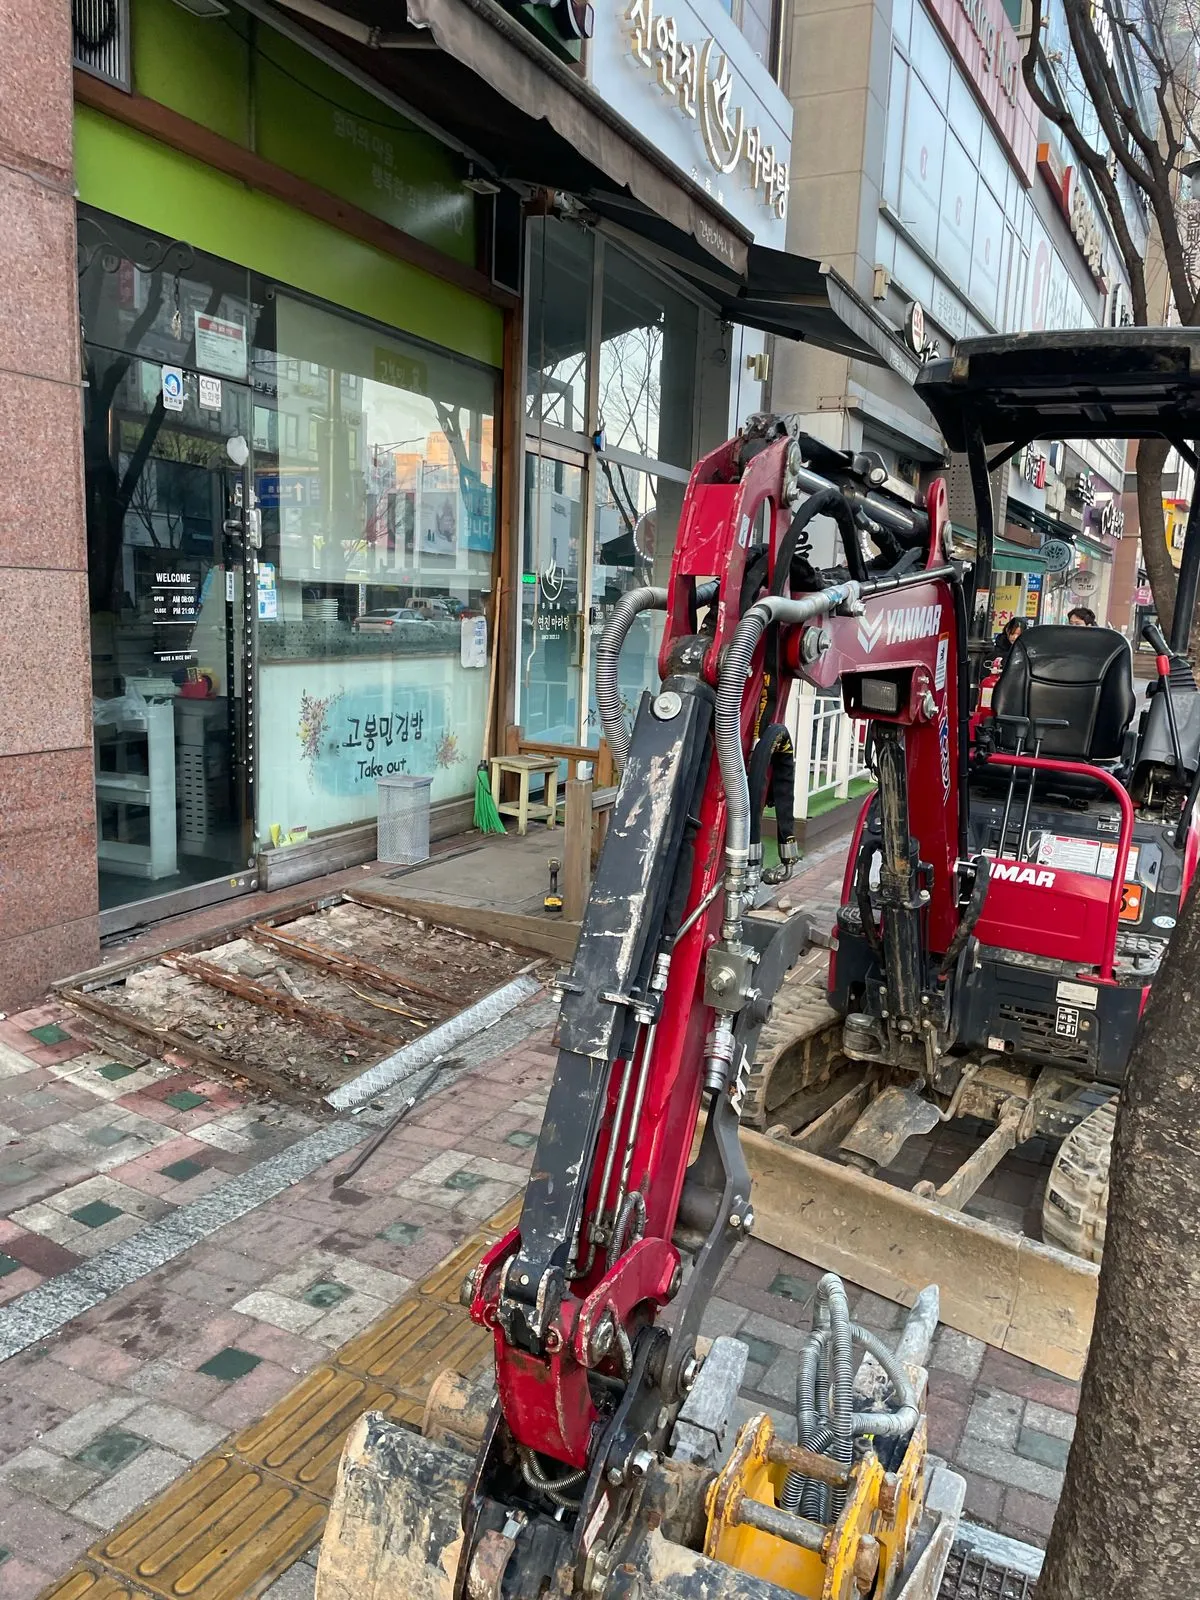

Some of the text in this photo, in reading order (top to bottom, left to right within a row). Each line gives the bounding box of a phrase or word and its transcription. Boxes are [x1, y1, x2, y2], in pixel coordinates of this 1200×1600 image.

[747, 126, 790, 220] 마라탕
[200, 379, 220, 392] CCTV
[155, 572, 191, 583] WELCOME
[172, 595, 180, 603] AM
[180, 595, 195, 603] 08:00
[172, 607, 180, 615] PM
[181, 607, 195, 615] 21:00
[885, 604, 943, 646] YANMAR
[356, 755, 407, 780] Take out
[988, 862, 1057, 889] MAR
